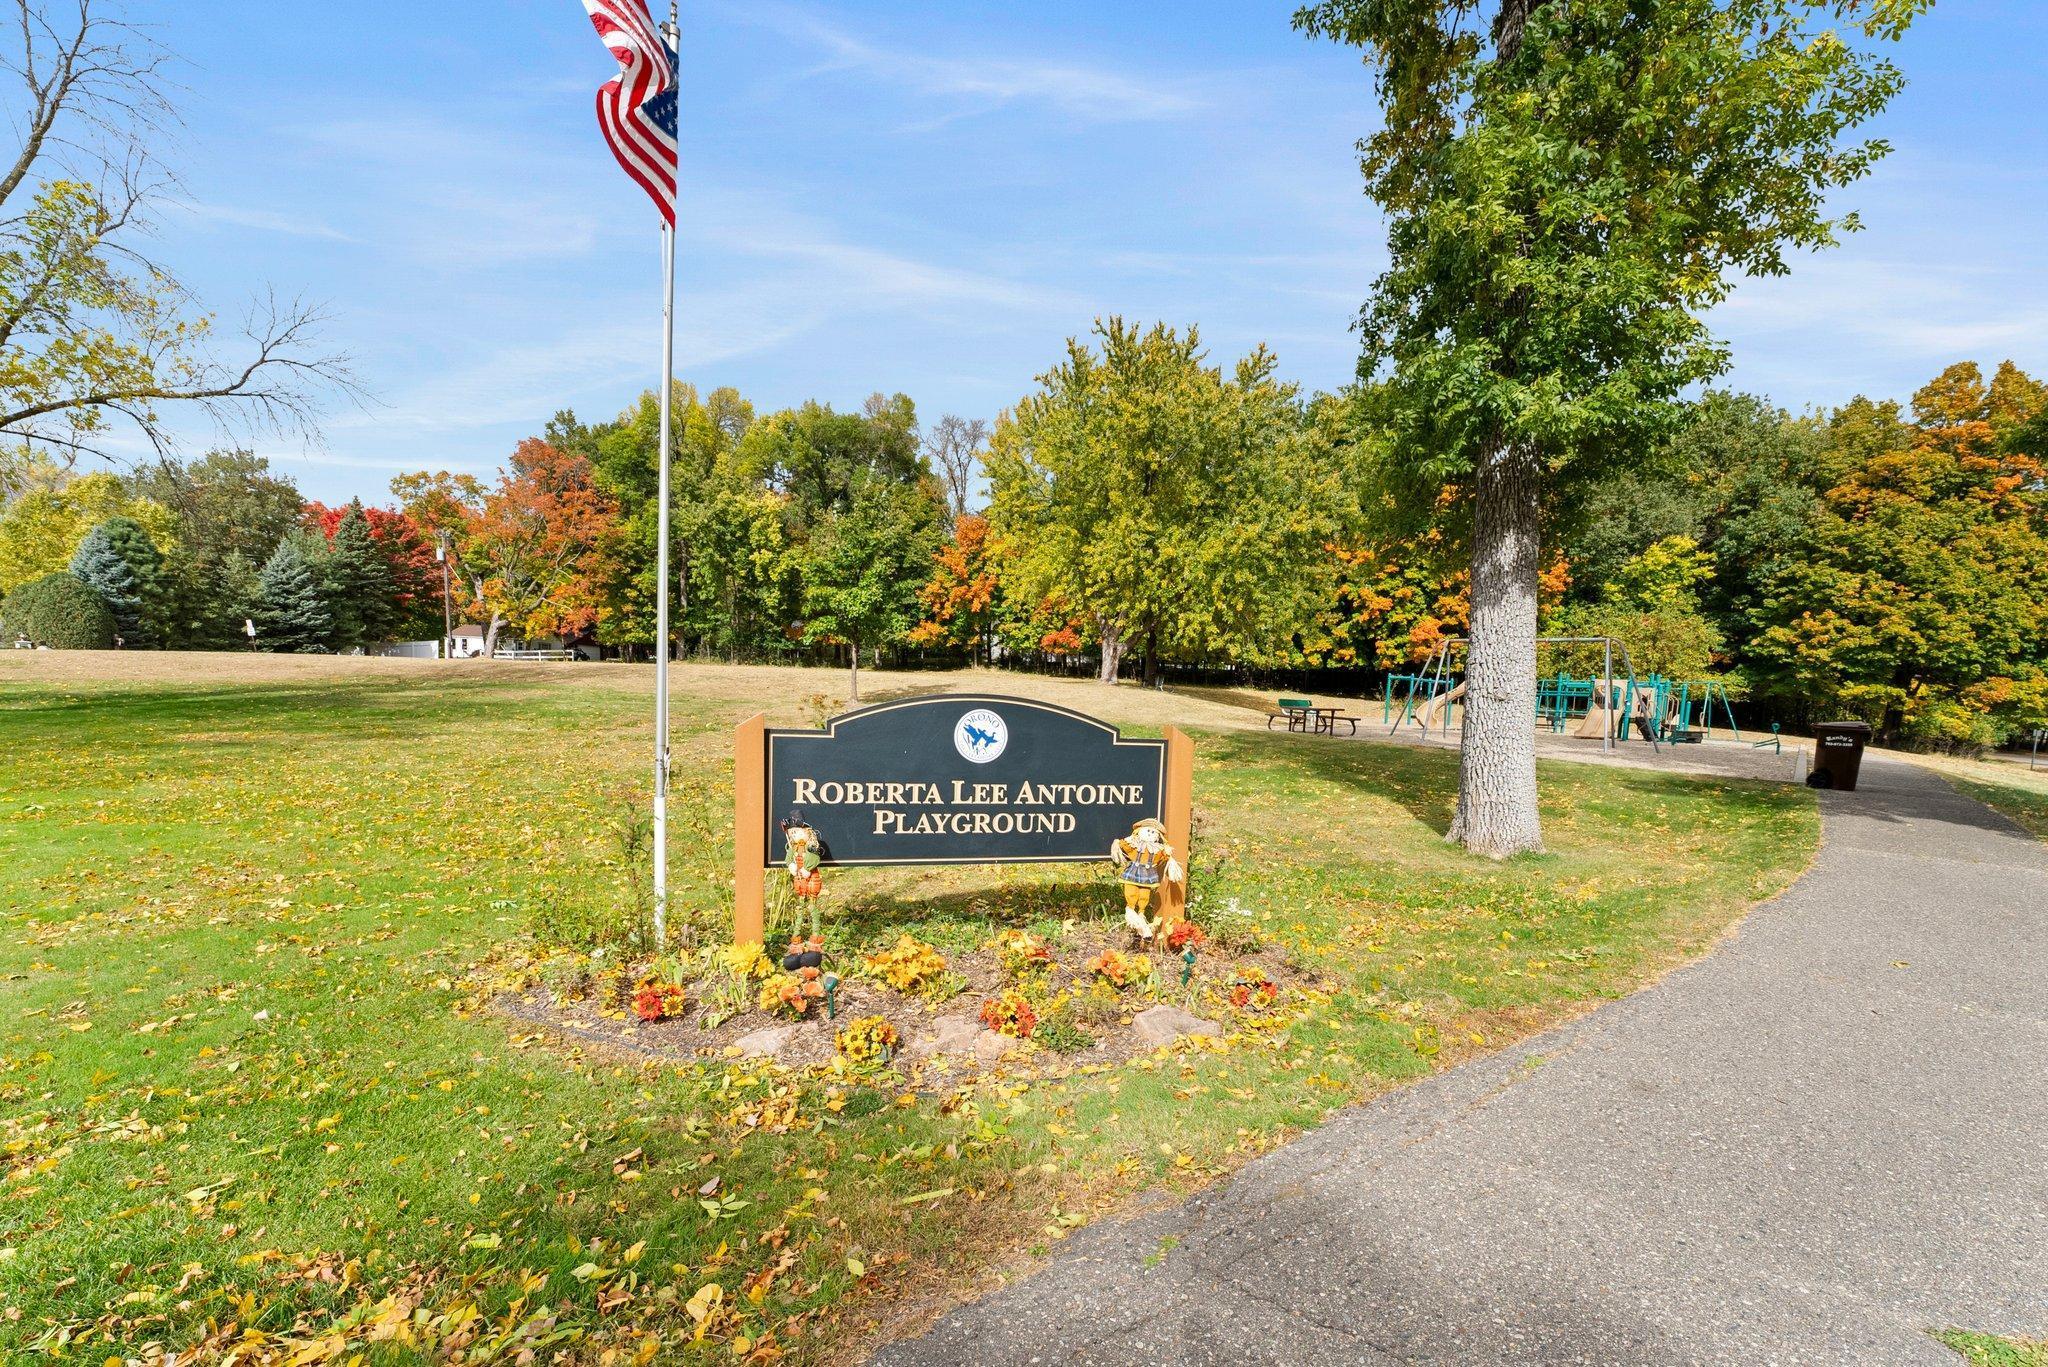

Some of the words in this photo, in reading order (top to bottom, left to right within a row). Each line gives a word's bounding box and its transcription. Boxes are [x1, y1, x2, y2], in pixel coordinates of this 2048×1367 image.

[963, 713, 1000, 728] ORONO
[792, 778, 945, 805] ROBERTA
[950, 780, 1008, 805] LEE
[1013, 780, 1144, 806] ANTOINE
[872, 809, 1077, 835] PLAYGROUND
